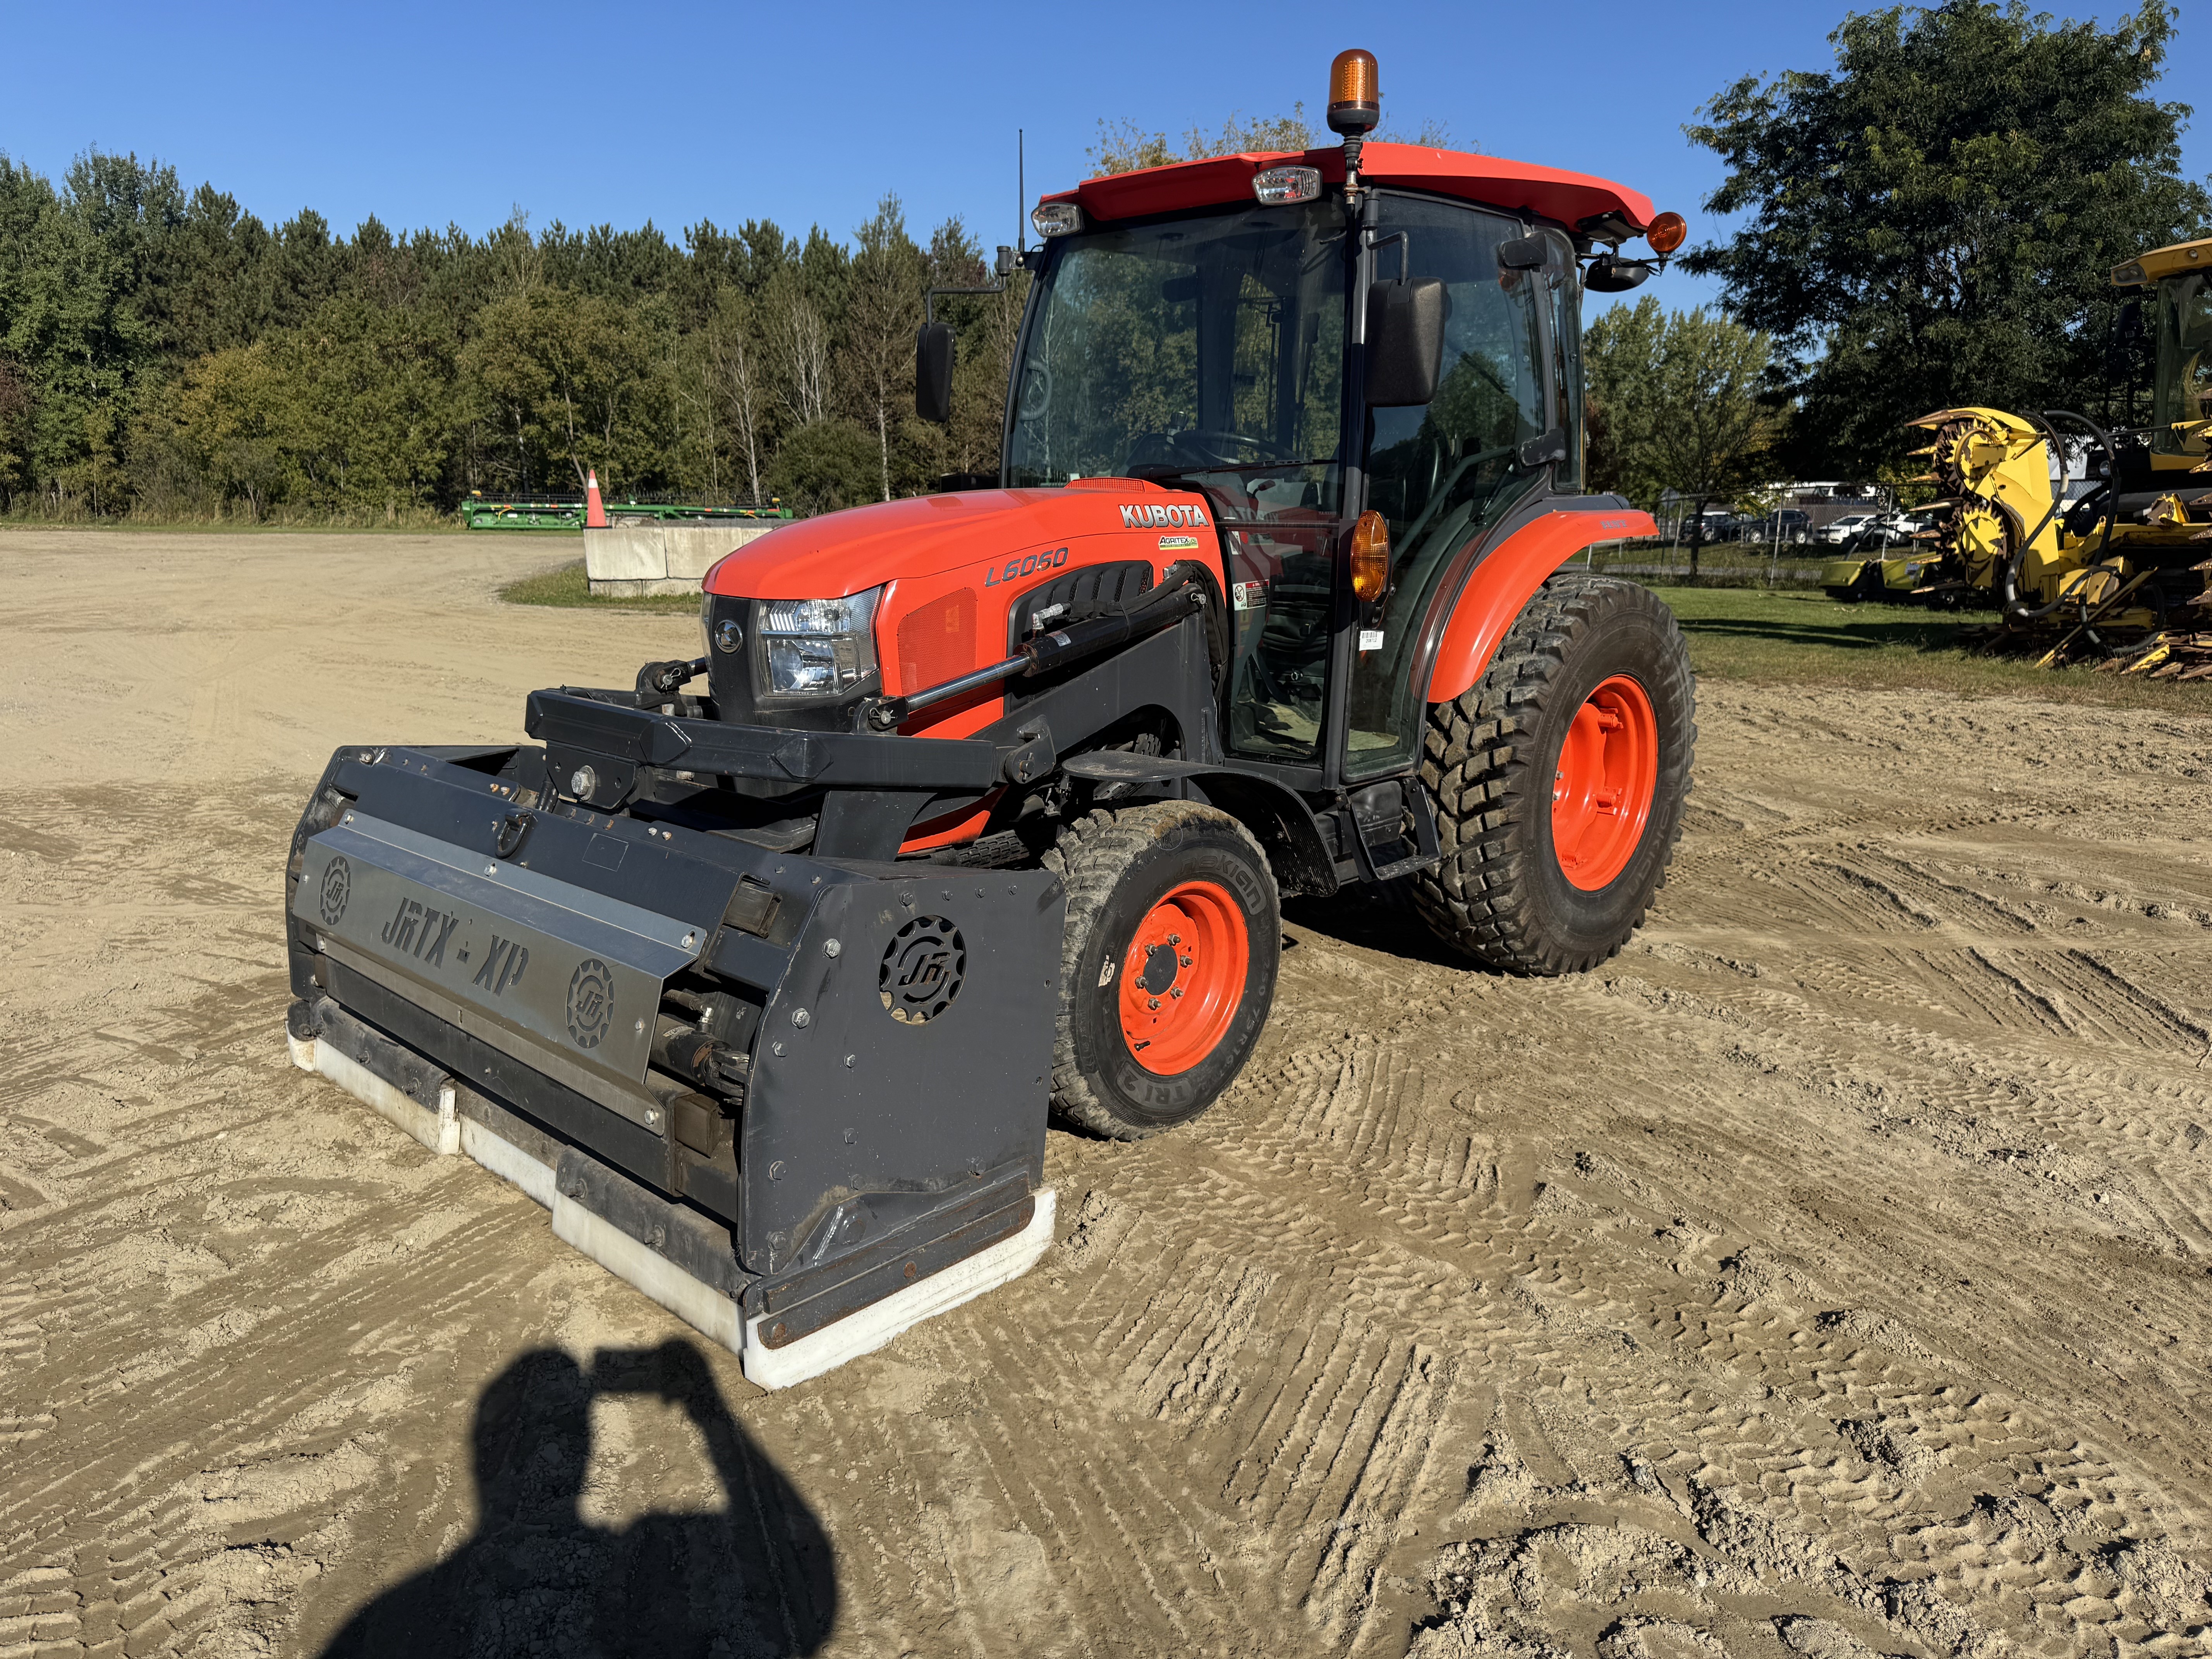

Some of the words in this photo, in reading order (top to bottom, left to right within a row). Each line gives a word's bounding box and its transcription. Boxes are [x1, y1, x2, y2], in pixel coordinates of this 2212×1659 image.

[1118, 504, 1210, 528] KUBOTA
[985, 547, 1068, 587] L6060
[381, 897, 459, 969] JRTX
[472, 934, 529, 997] XP
